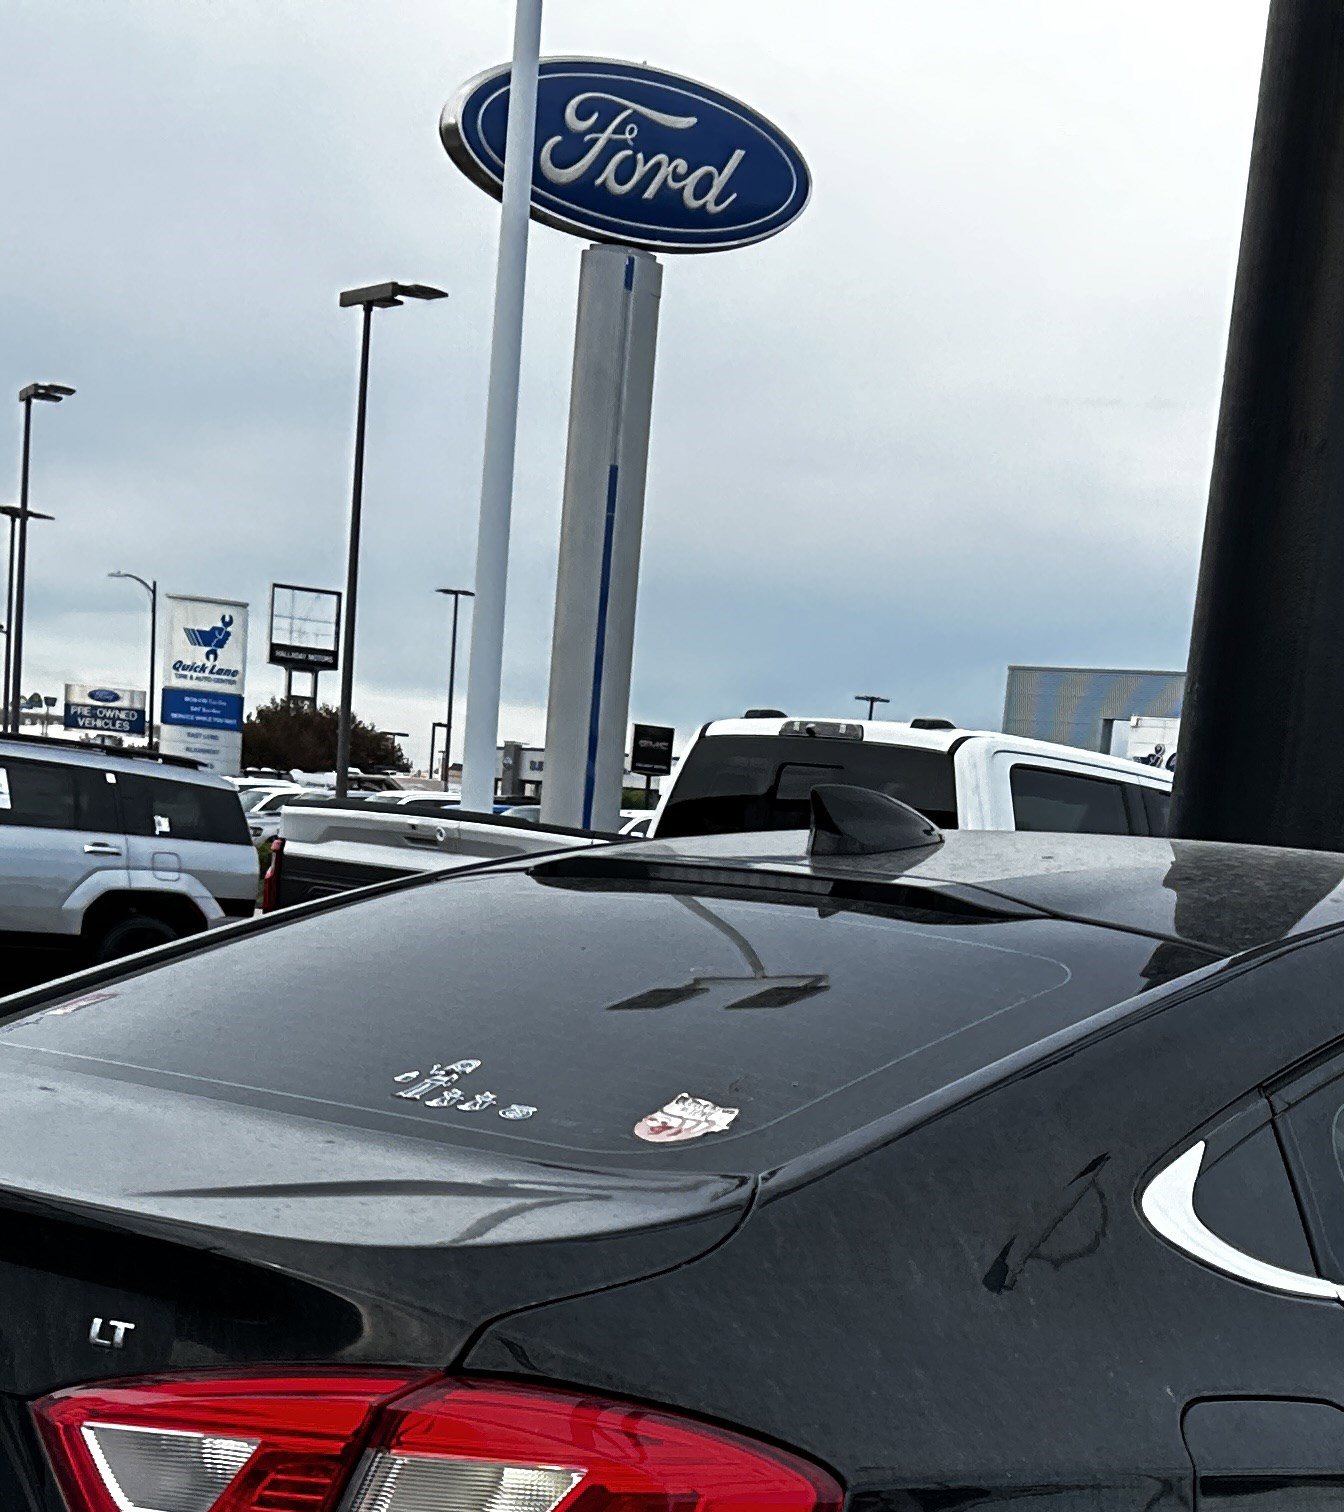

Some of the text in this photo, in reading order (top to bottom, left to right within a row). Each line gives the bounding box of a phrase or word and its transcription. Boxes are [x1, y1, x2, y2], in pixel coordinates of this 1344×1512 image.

[539, 91, 746, 215] Ford
[172, 660, 239, 678] Quick Lane
[77, 717, 131, 732] VEHICLES
[89, 1317, 136, 1348] LT
